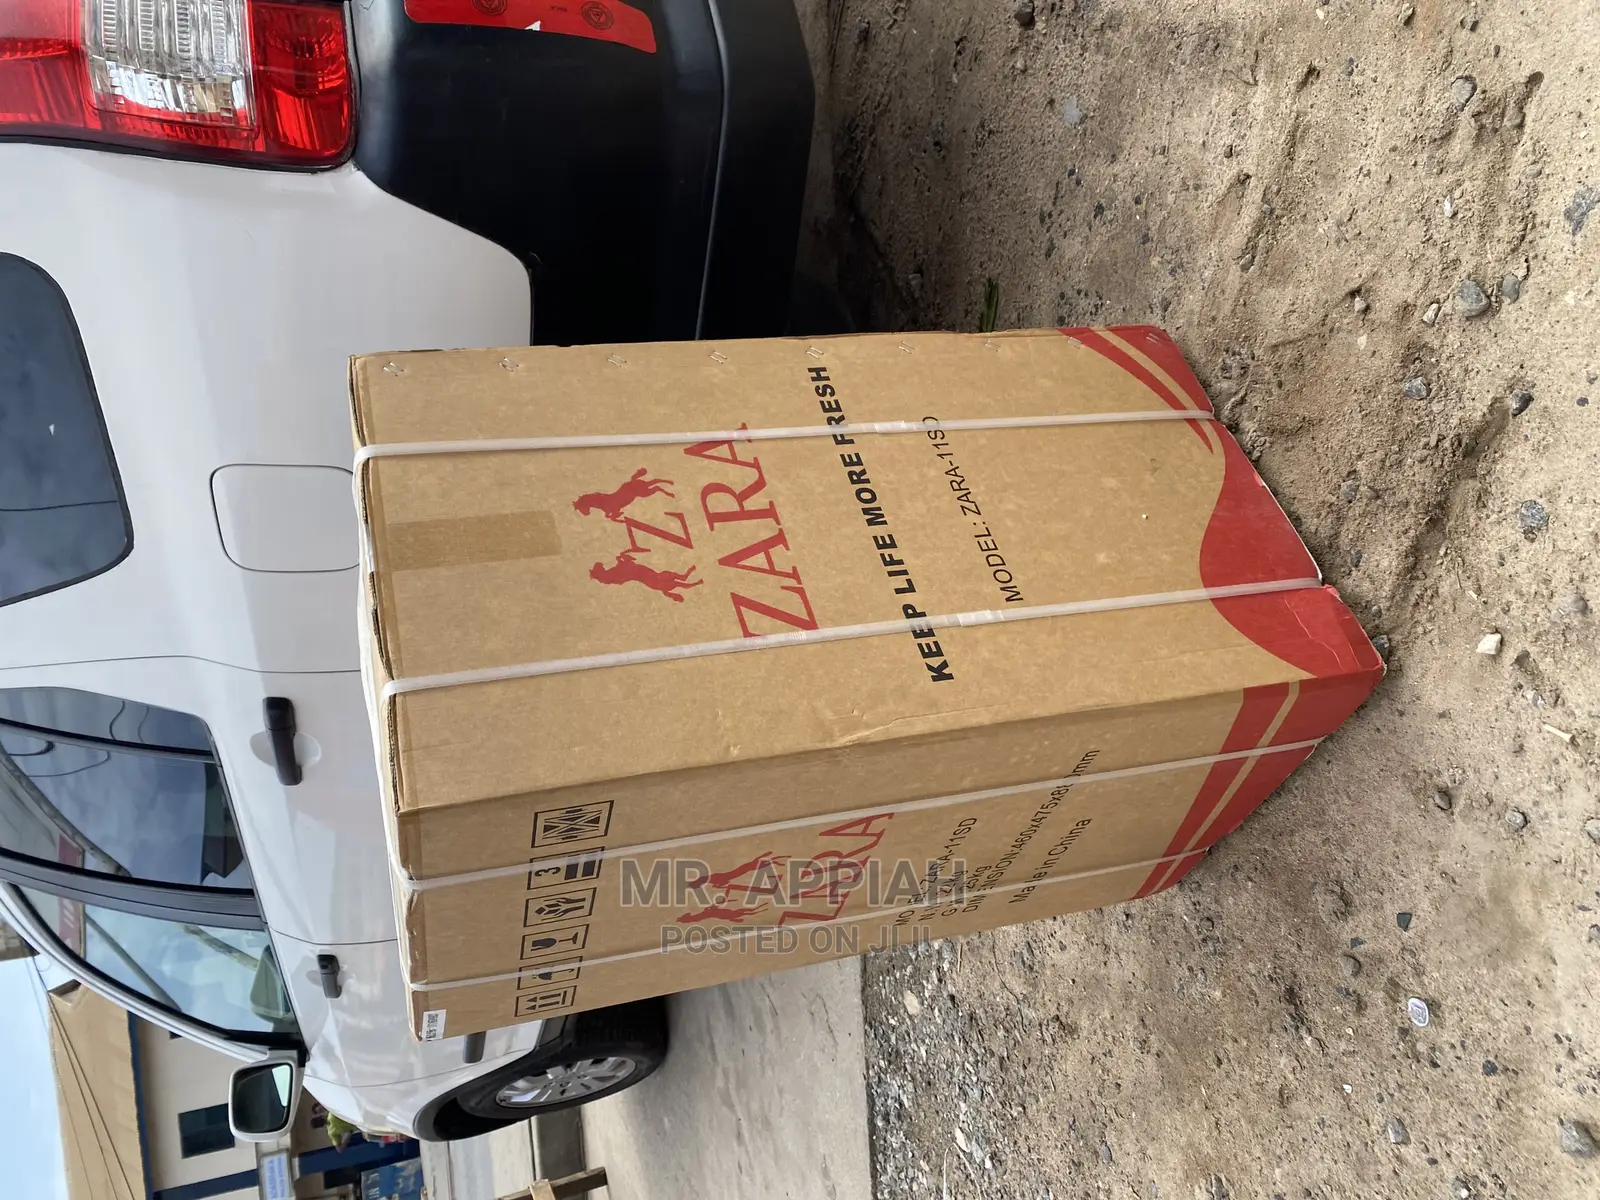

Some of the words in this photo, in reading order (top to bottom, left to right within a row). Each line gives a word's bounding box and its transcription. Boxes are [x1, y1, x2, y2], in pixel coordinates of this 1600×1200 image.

[807, 365, 856, 446] FRESH
[840, 451, 888, 526] MORE
[922, 415, 981, 517] ZARA-11SD
[683, 422, 819, 638] ZARA
[874, 532, 917, 595] LIFE
[973, 519, 1024, 602] MODEL:
[902, 603, 955, 682] KEEP
[534, 866, 562, 877] 3
[777, 812, 895, 928] ZARA
[896, 817, 978, 926] MOEL:ZARA-11SD
[1035, 857, 1058, 876] in
[1047, 818, 1093, 857] China
